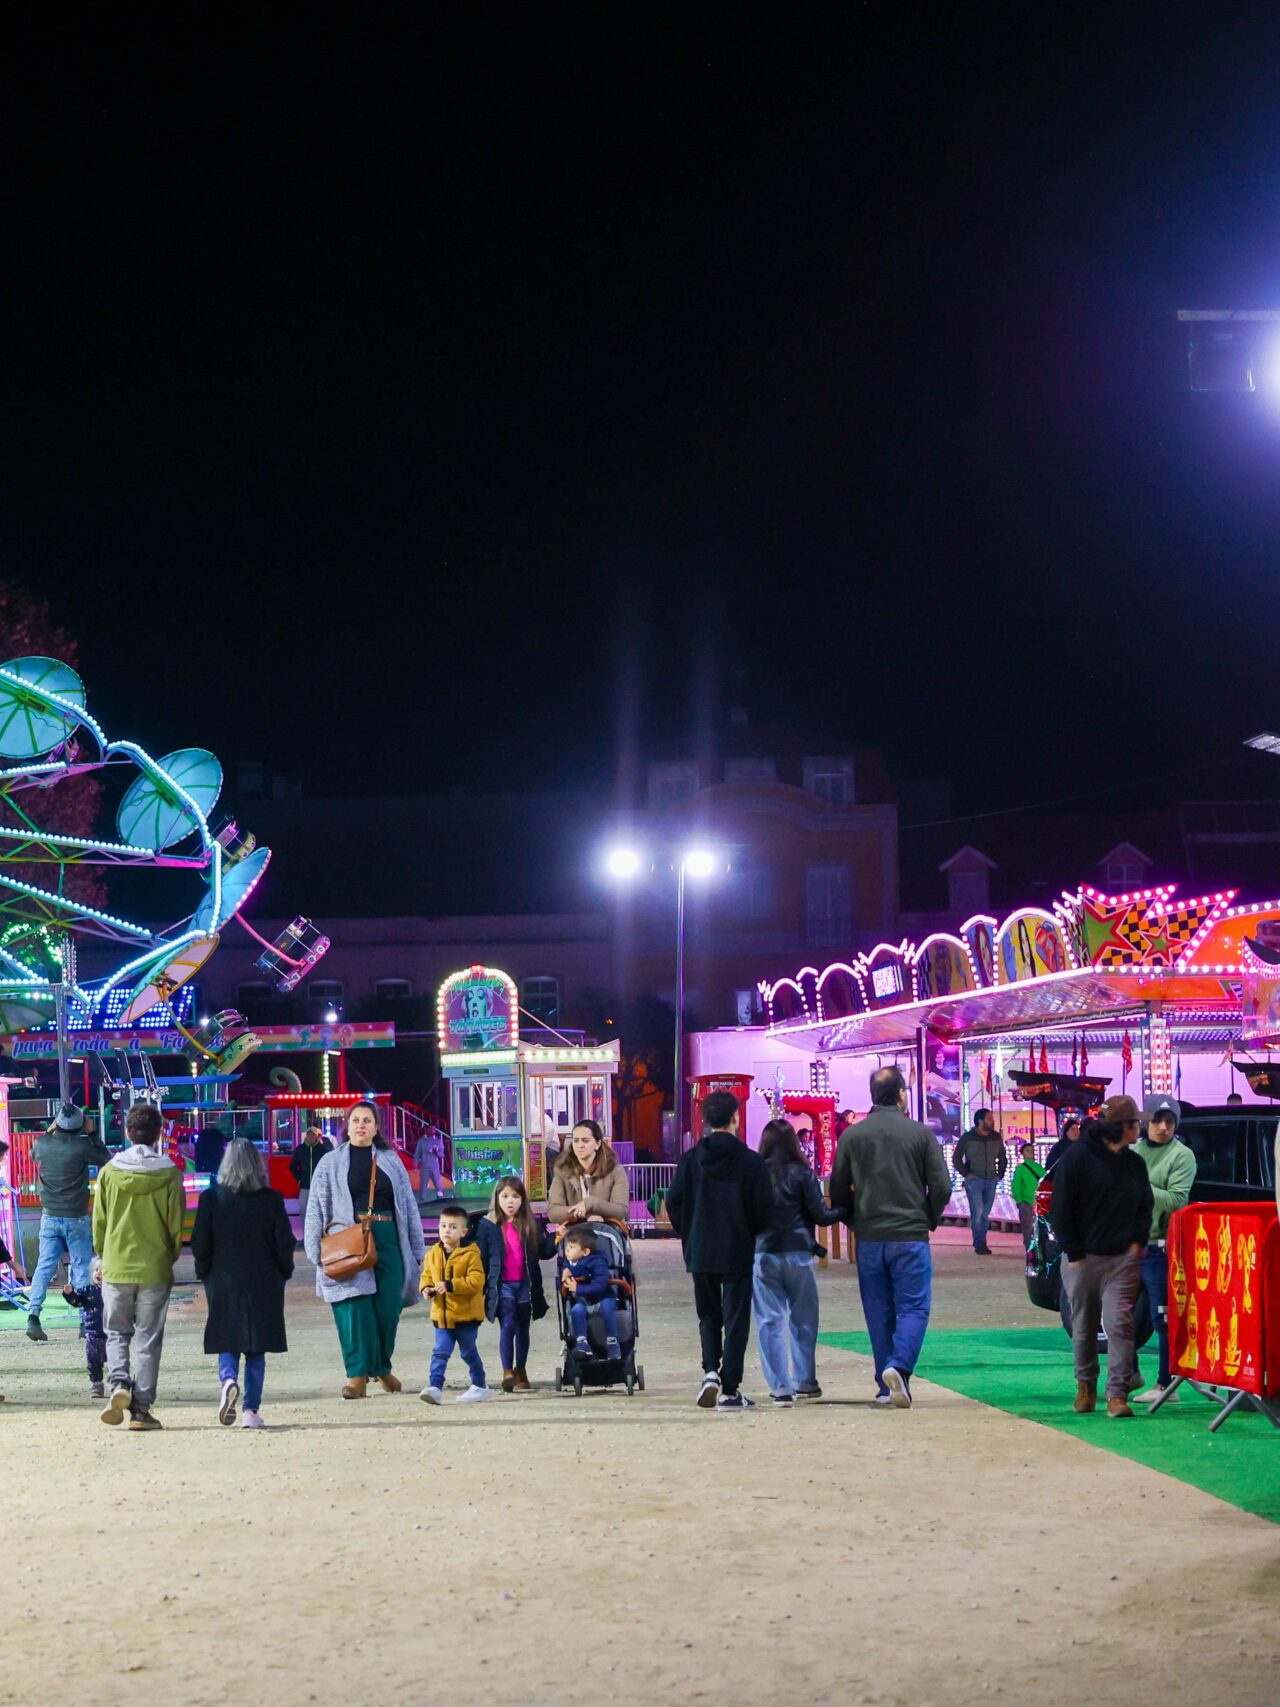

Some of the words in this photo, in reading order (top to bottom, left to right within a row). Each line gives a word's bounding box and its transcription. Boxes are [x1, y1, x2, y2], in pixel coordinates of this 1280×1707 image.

[12, 1039, 54, 1057] para
[73, 1035, 111, 1051] toda
[129, 1038, 142, 1051] a
[314, 1107, 345, 1118] TORADO
